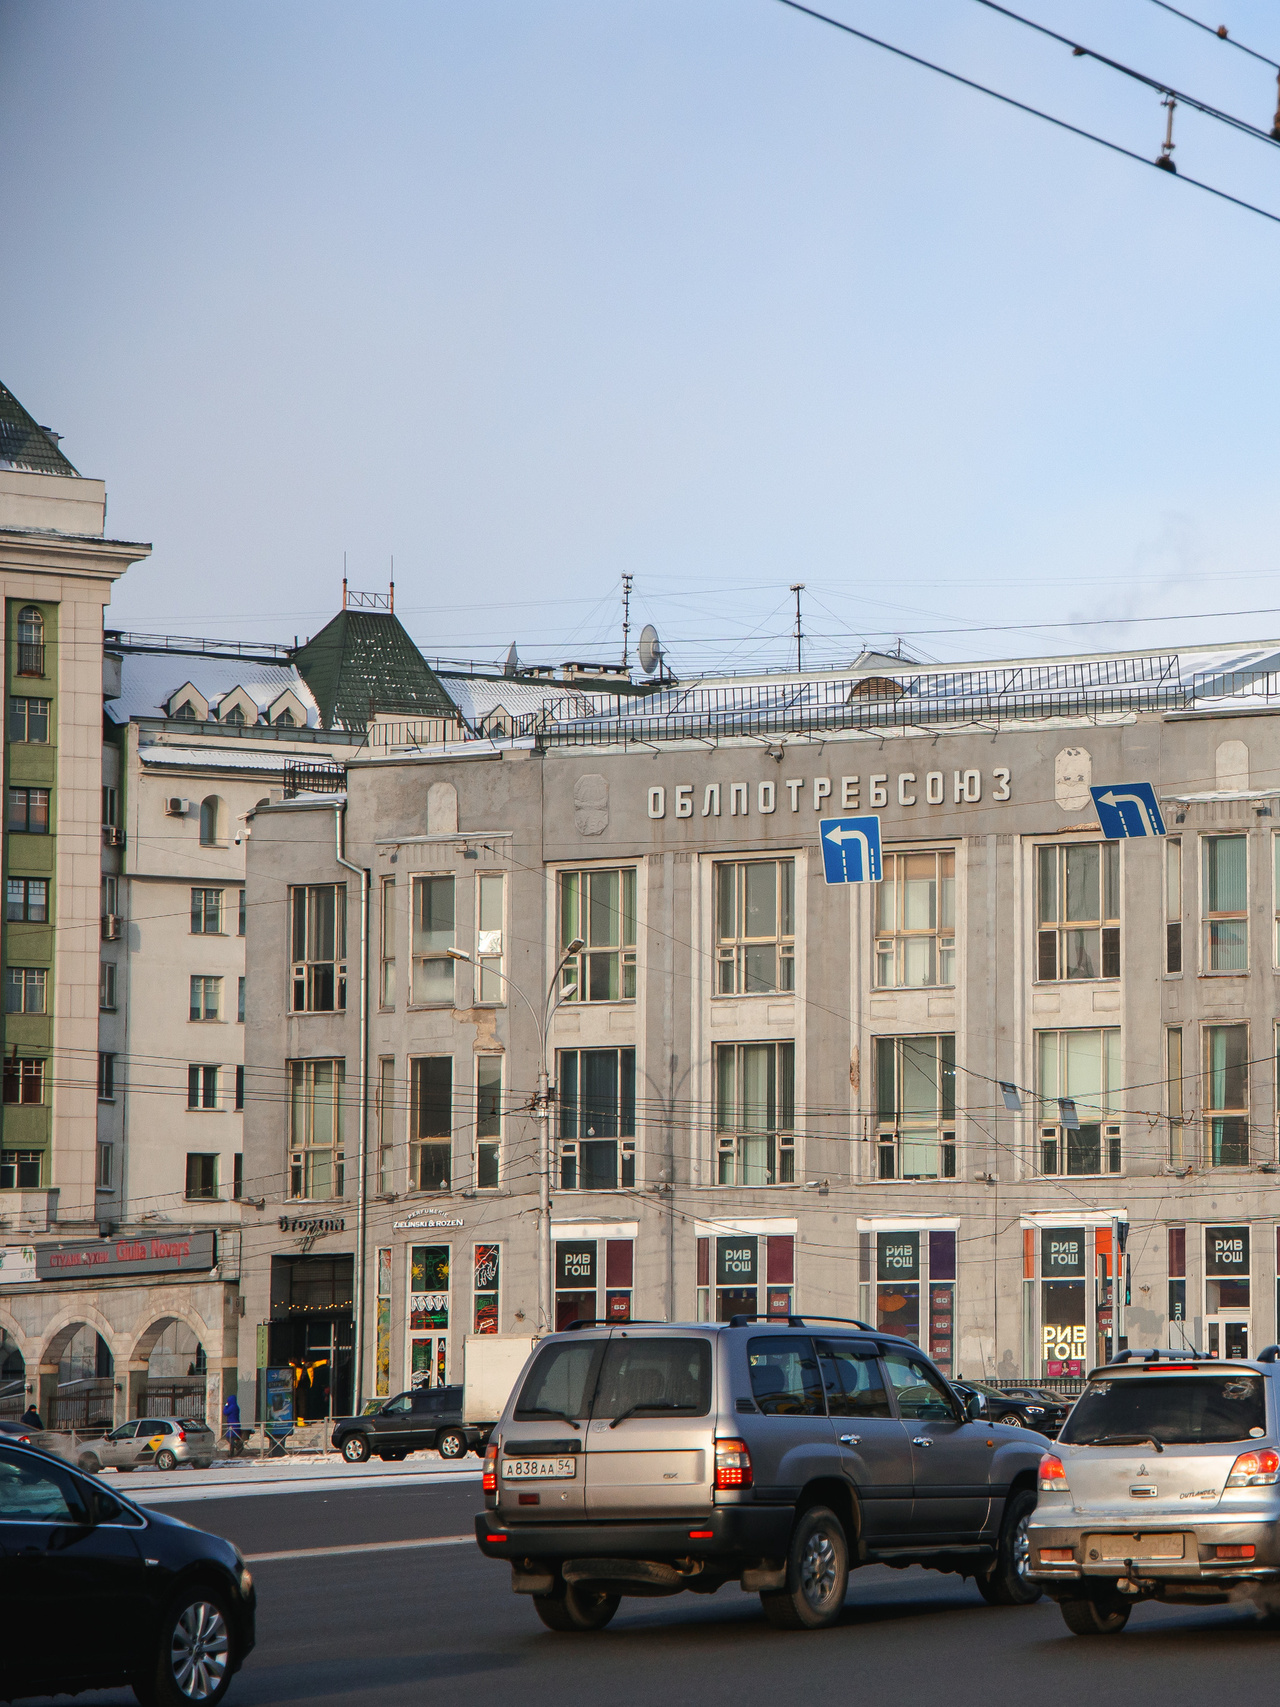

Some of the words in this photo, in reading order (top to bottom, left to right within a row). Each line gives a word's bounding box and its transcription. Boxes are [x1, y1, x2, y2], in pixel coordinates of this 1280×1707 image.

[647, 766, 1012, 819] ОБЛПОТРЕБСОЮЗ
[393, 1221, 427, 1229] ZIELINSKI
[428, 1219, 435, 1228] &
[436, 1218, 464, 1228] ROZEN
[886, 1245, 913, 1256] РИВ
[1051, 1242, 1079, 1253] РИВ
[1215, 1239, 1243, 1251] РИВ
[564, 1253, 591, 1264] РИВ
[725, 1249, 752, 1260] РИВ
[1051, 1253, 1079, 1265] ГОШ
[1215, 1251, 1243, 1263] ГОШ
[725, 1260, 752, 1272] ГОШ
[886, 1256, 913, 1268] ГОШ
[564, 1264, 591, 1276] ГОШ
[1043, 1325, 1087, 1343] РИВ
[1043, 1343, 1087, 1360] ГОШ
[558, 1459, 571, 1471] 54
[1179, 1488, 1217, 1500] OUTLANDER
